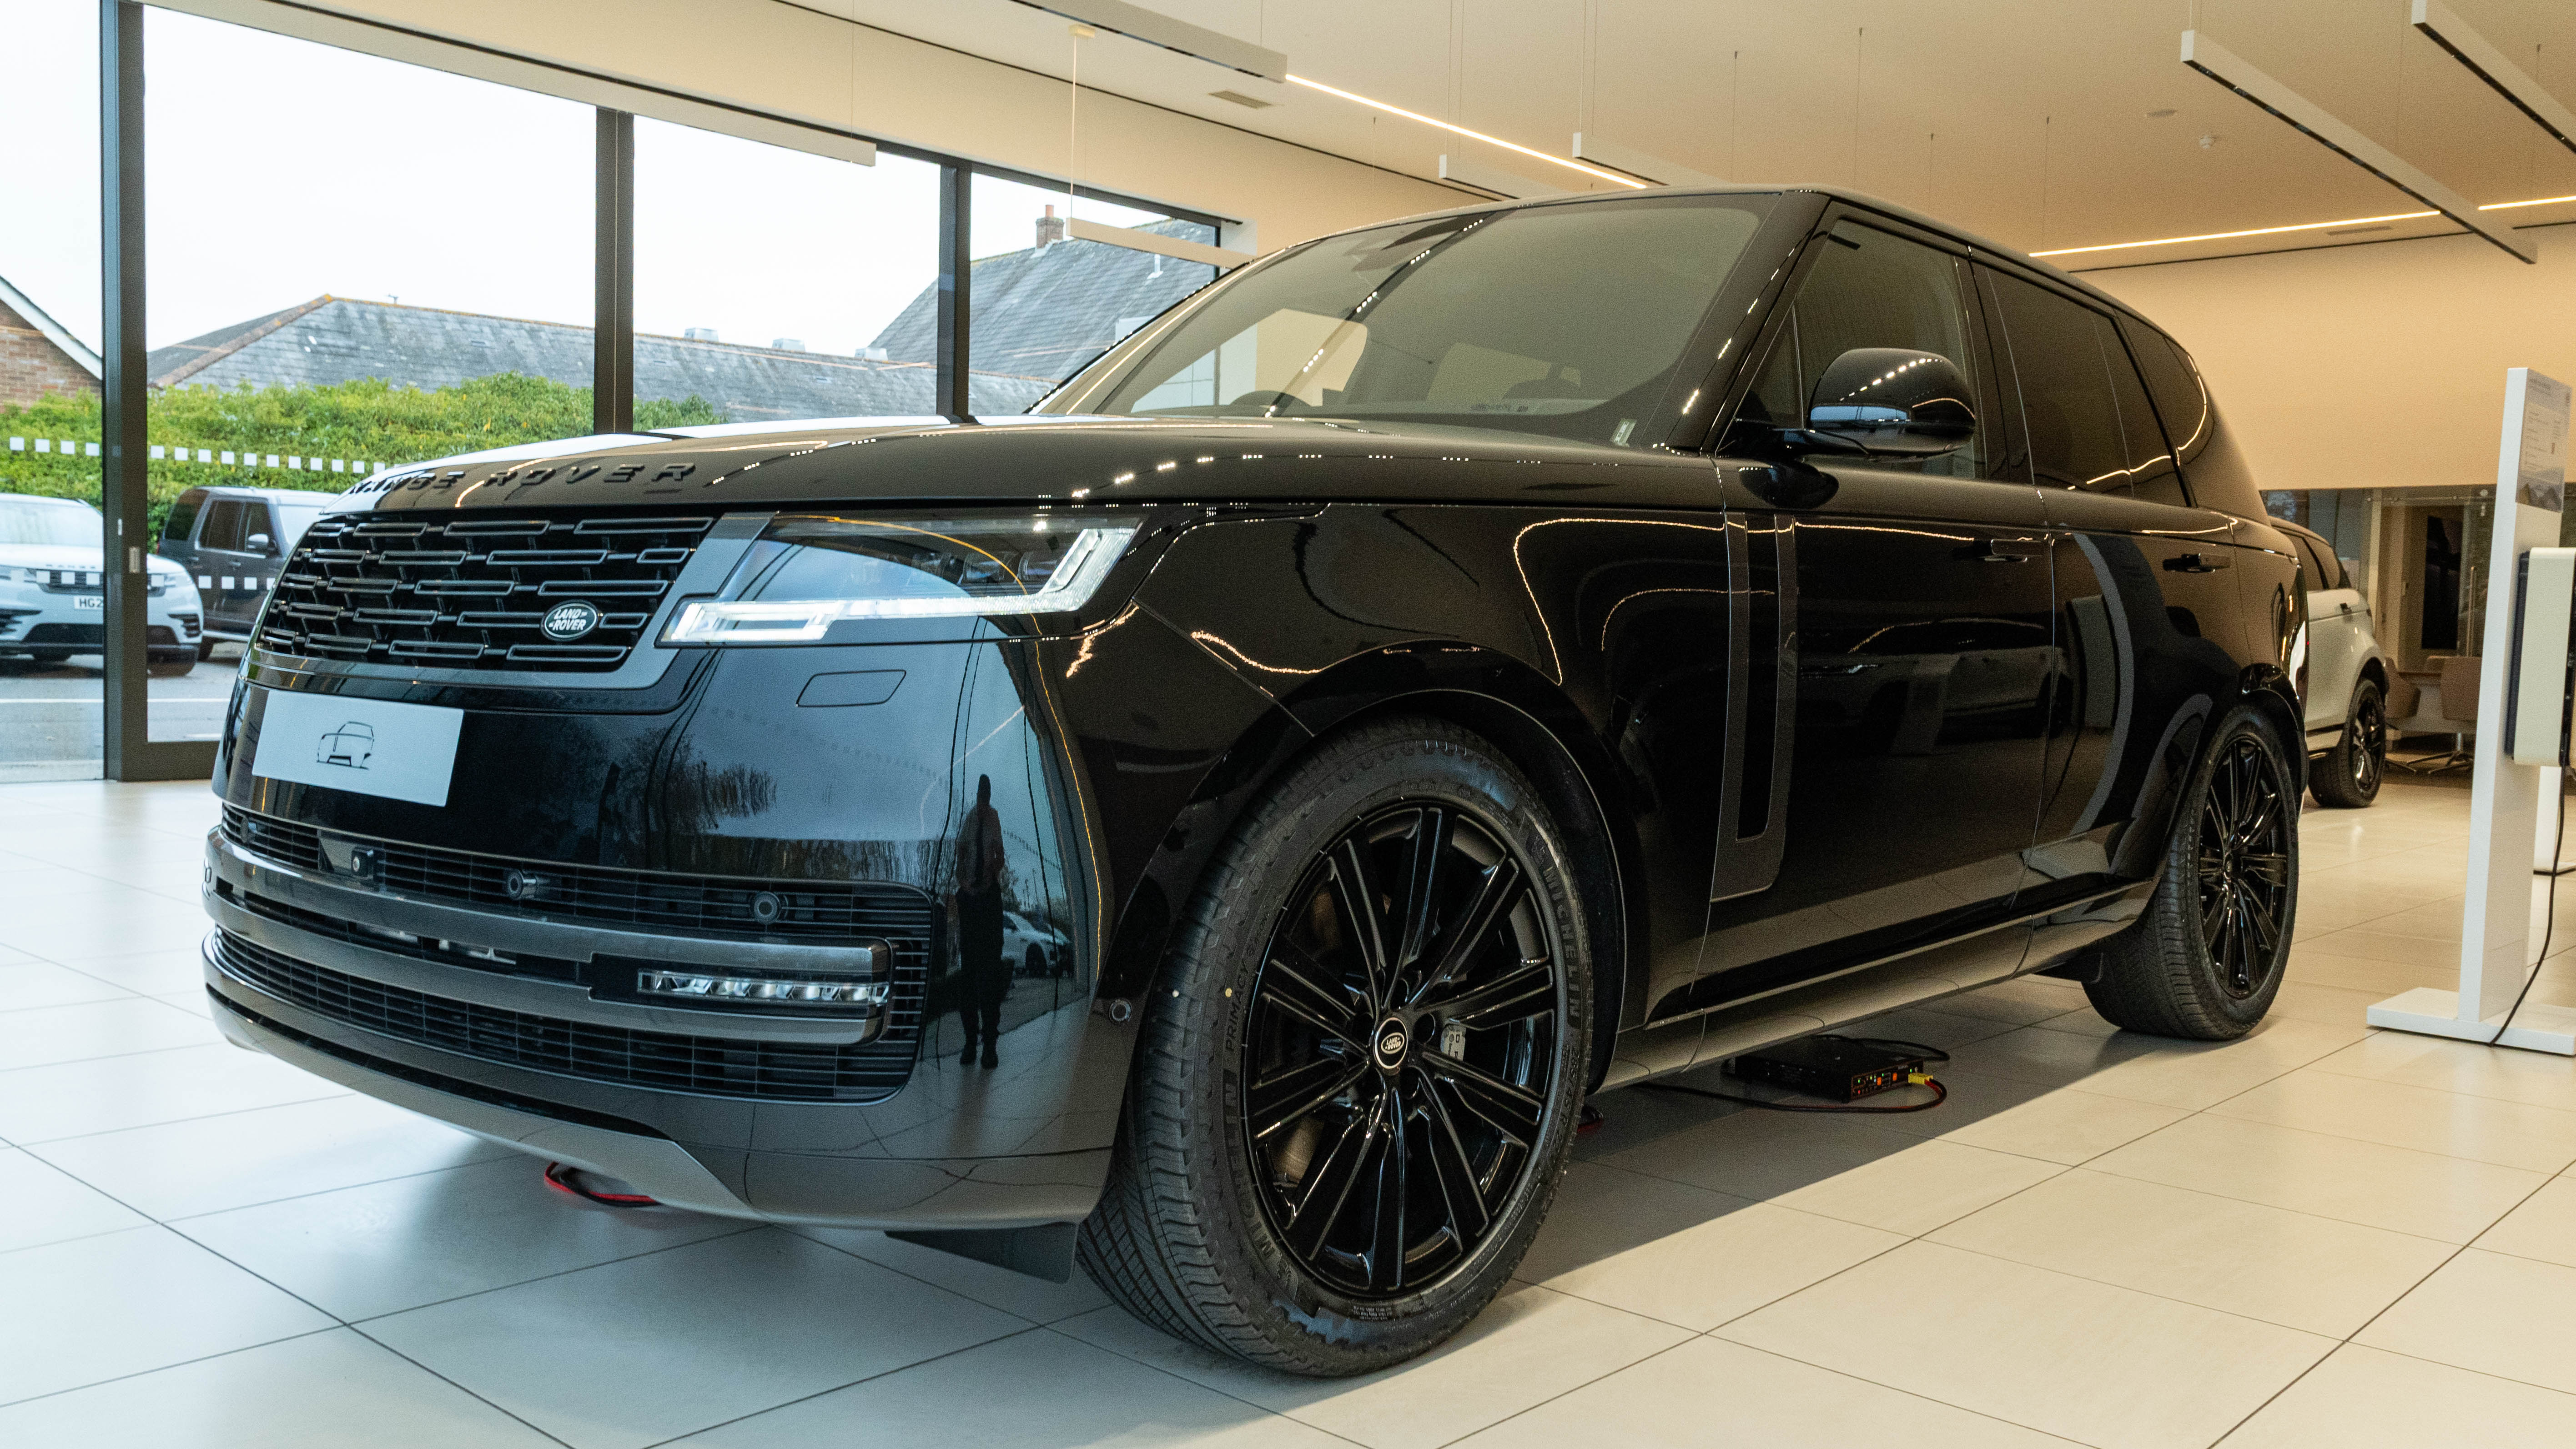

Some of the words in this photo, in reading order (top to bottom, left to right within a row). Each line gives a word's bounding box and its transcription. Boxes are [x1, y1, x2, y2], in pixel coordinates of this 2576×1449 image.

[483, 462, 696, 487] ROVER
[554, 608, 582, 619] LAND
[552, 619, 587, 631] ROVER
[1542, 866, 1580, 1018] MICHELIN
[1225, 959, 1249, 1053] PRIMACY
[1386, 1037, 1398, 1045] LAND
[1387, 1041, 1401, 1050] ROVER
